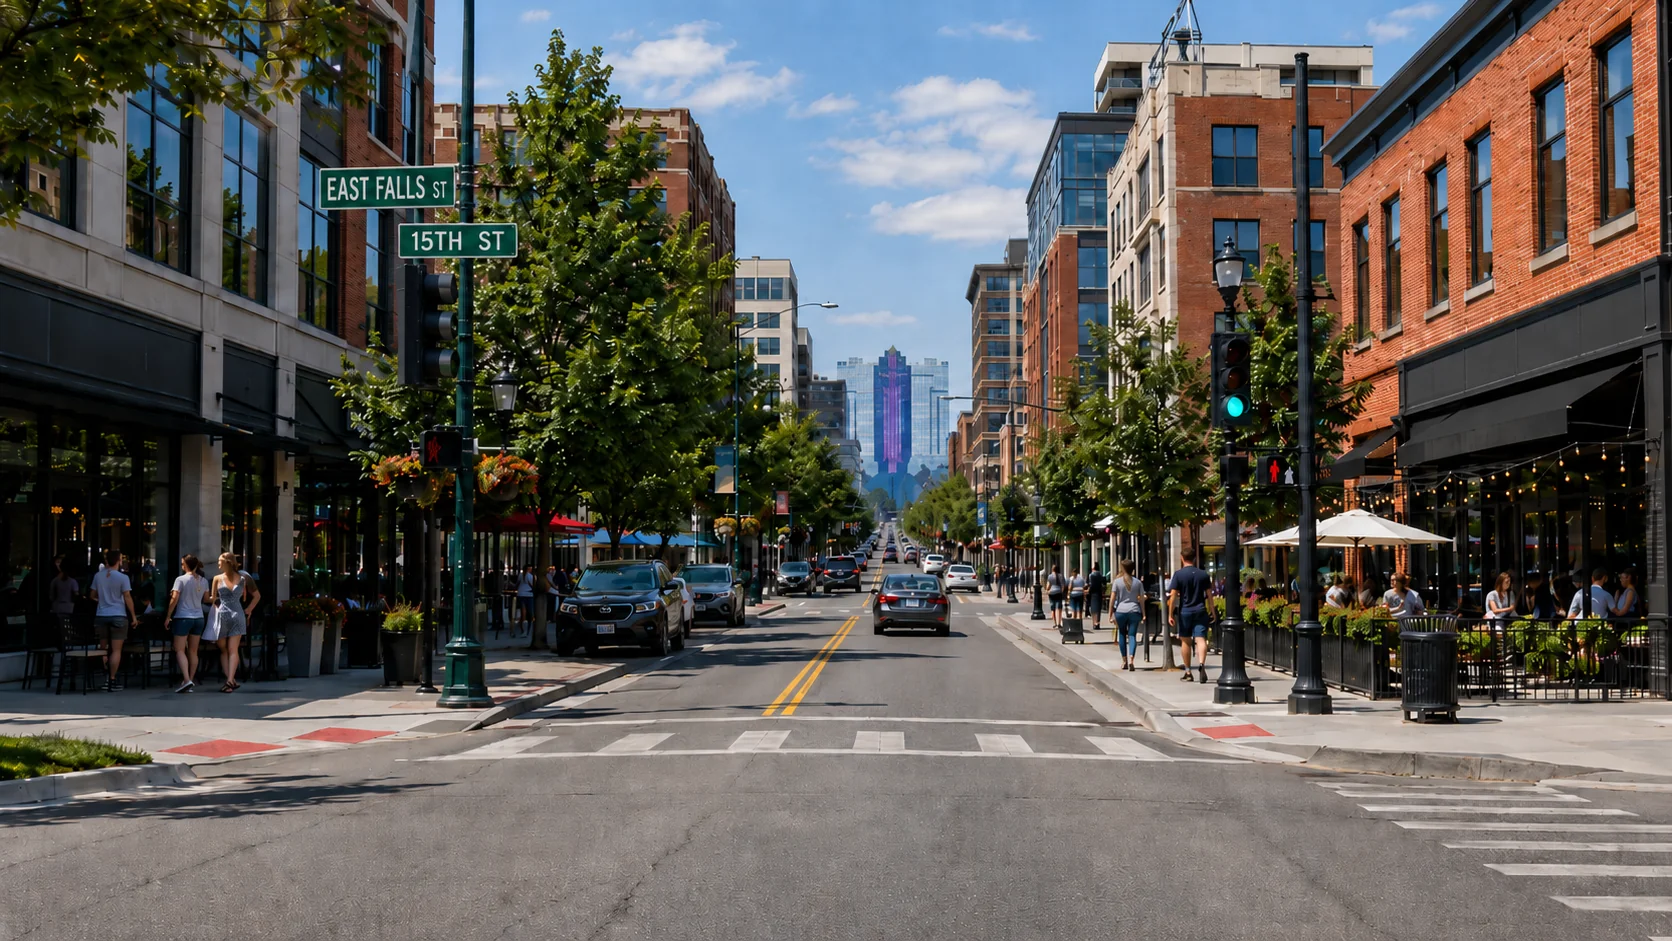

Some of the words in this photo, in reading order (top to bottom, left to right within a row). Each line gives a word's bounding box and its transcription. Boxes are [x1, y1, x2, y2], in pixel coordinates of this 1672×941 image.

[327, 176, 370, 202] EAST
[376, 174, 426, 201] FALLS
[432, 181, 447, 199] ST
[411, 231, 462, 251] 15TH
[478, 231, 505, 251] ST
